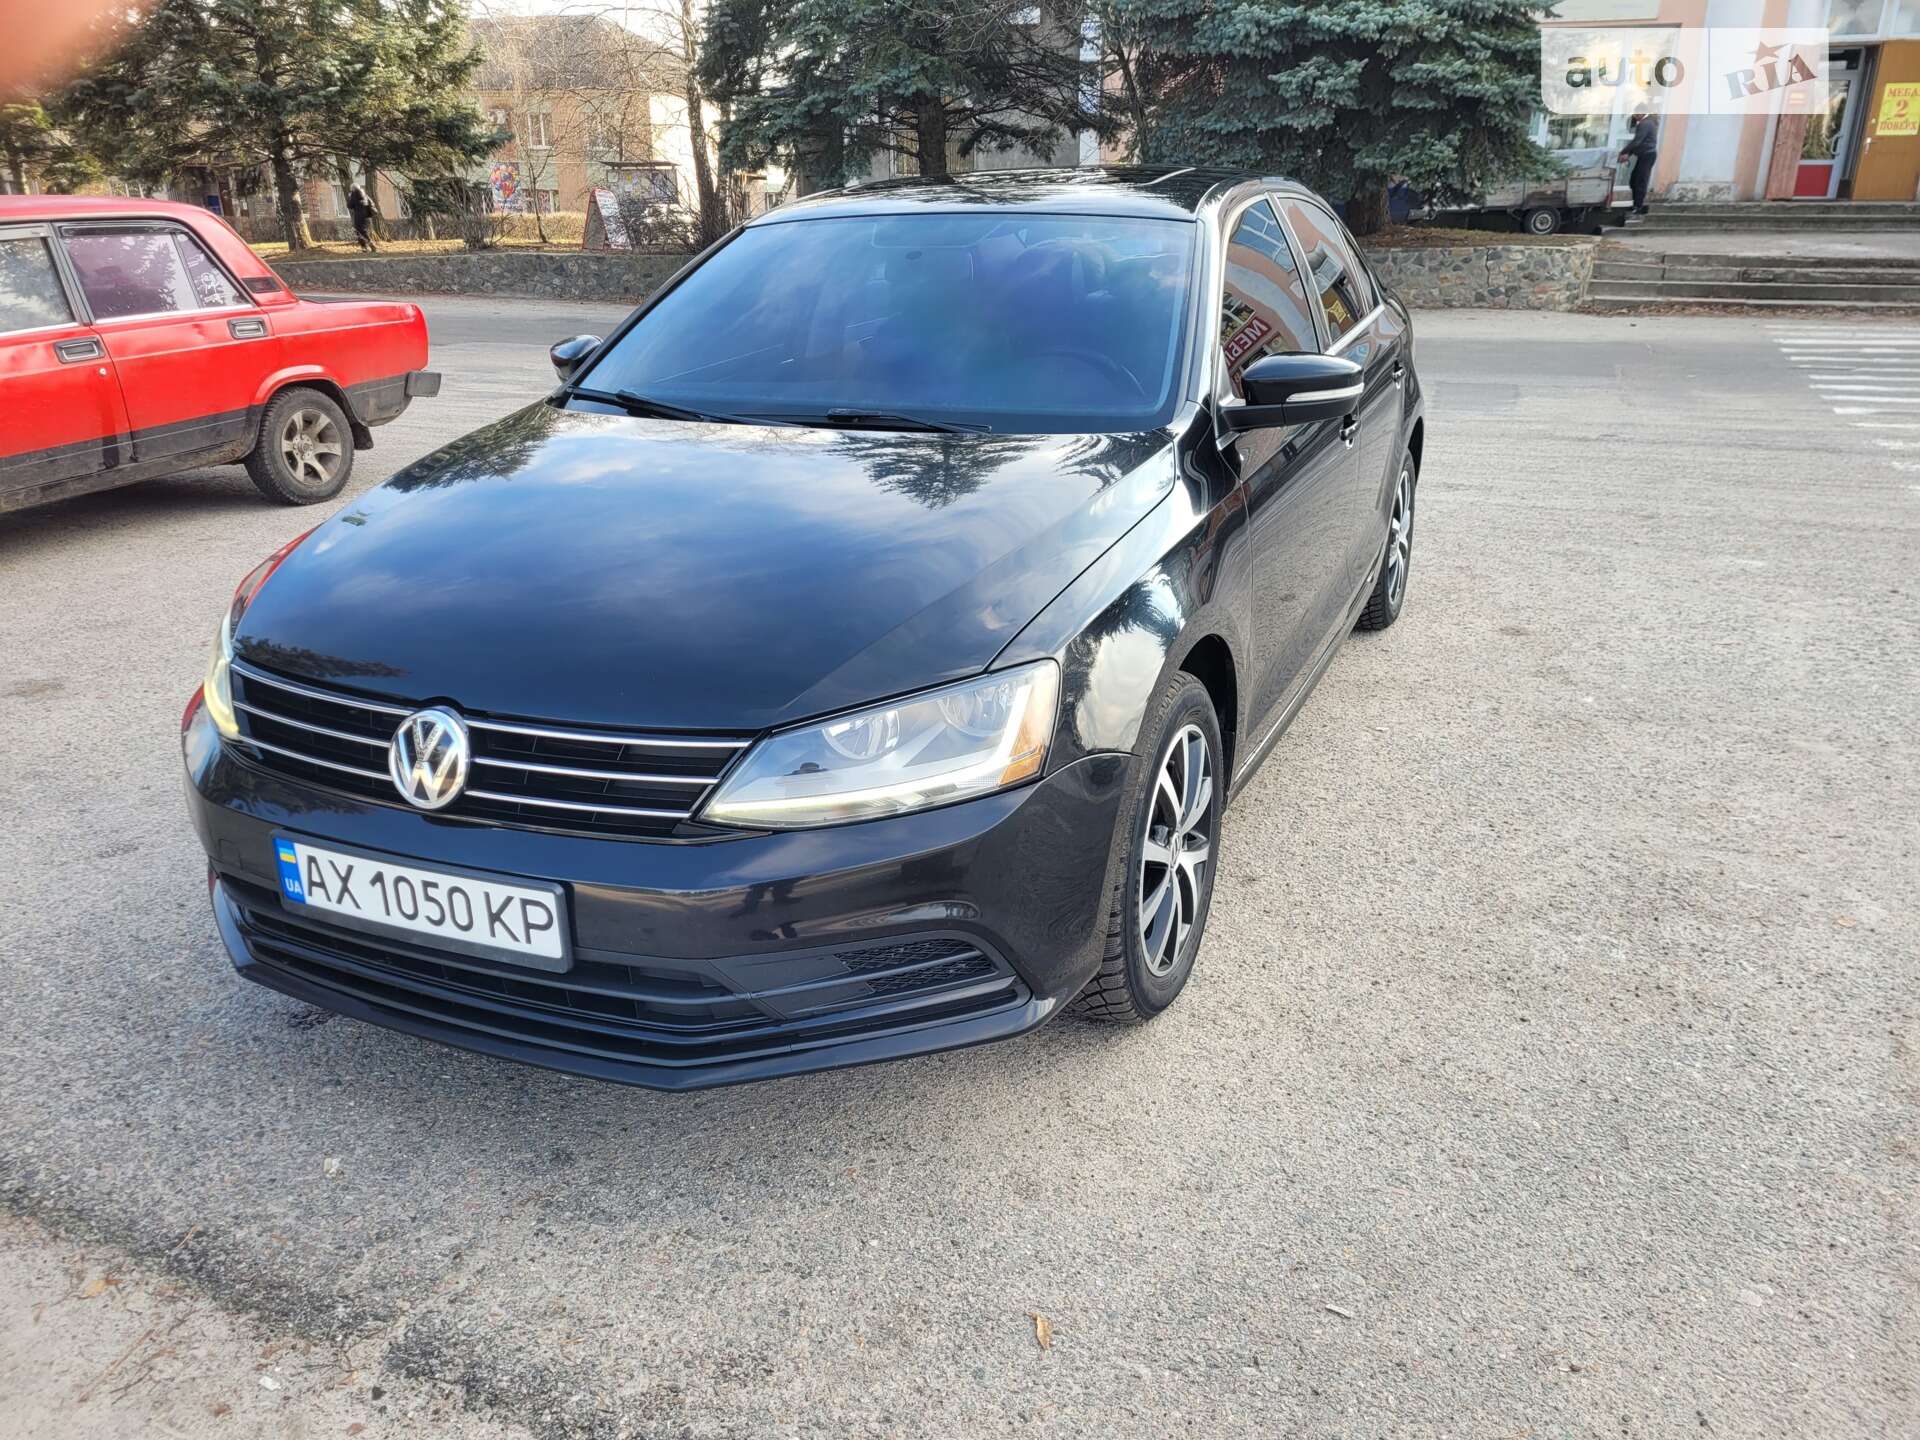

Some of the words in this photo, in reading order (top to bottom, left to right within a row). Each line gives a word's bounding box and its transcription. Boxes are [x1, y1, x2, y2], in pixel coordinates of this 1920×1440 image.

[1887, 87, 1920, 97] МЕБЛ
[1894, 99, 1909, 118] 2
[284, 877, 303, 895] UA
[306, 855, 362, 910] AX
[369, 870, 474, 932] 1050
[483, 891, 554, 945] KP
